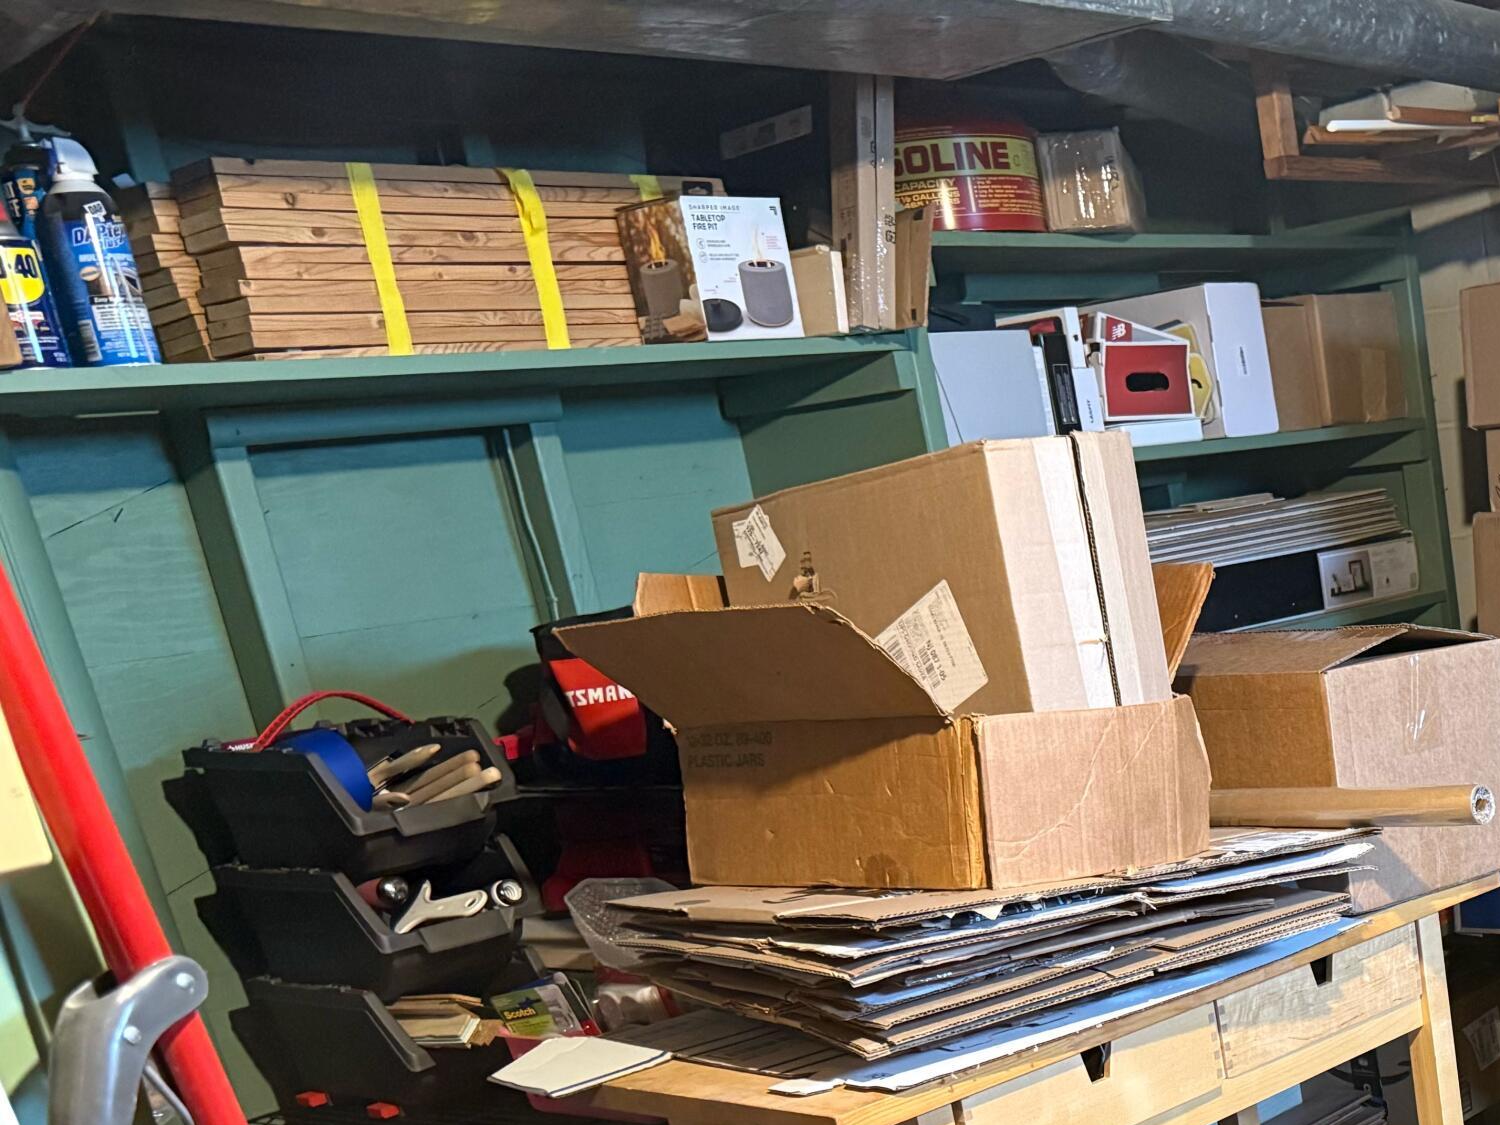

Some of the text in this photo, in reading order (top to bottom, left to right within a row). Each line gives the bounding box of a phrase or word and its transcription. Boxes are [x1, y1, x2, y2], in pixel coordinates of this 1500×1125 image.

[691, 213, 726, 223] TABLETOP
[693, 222, 718, 231] FIRE PIT
[503, 1006, 537, 1020] Scotch
